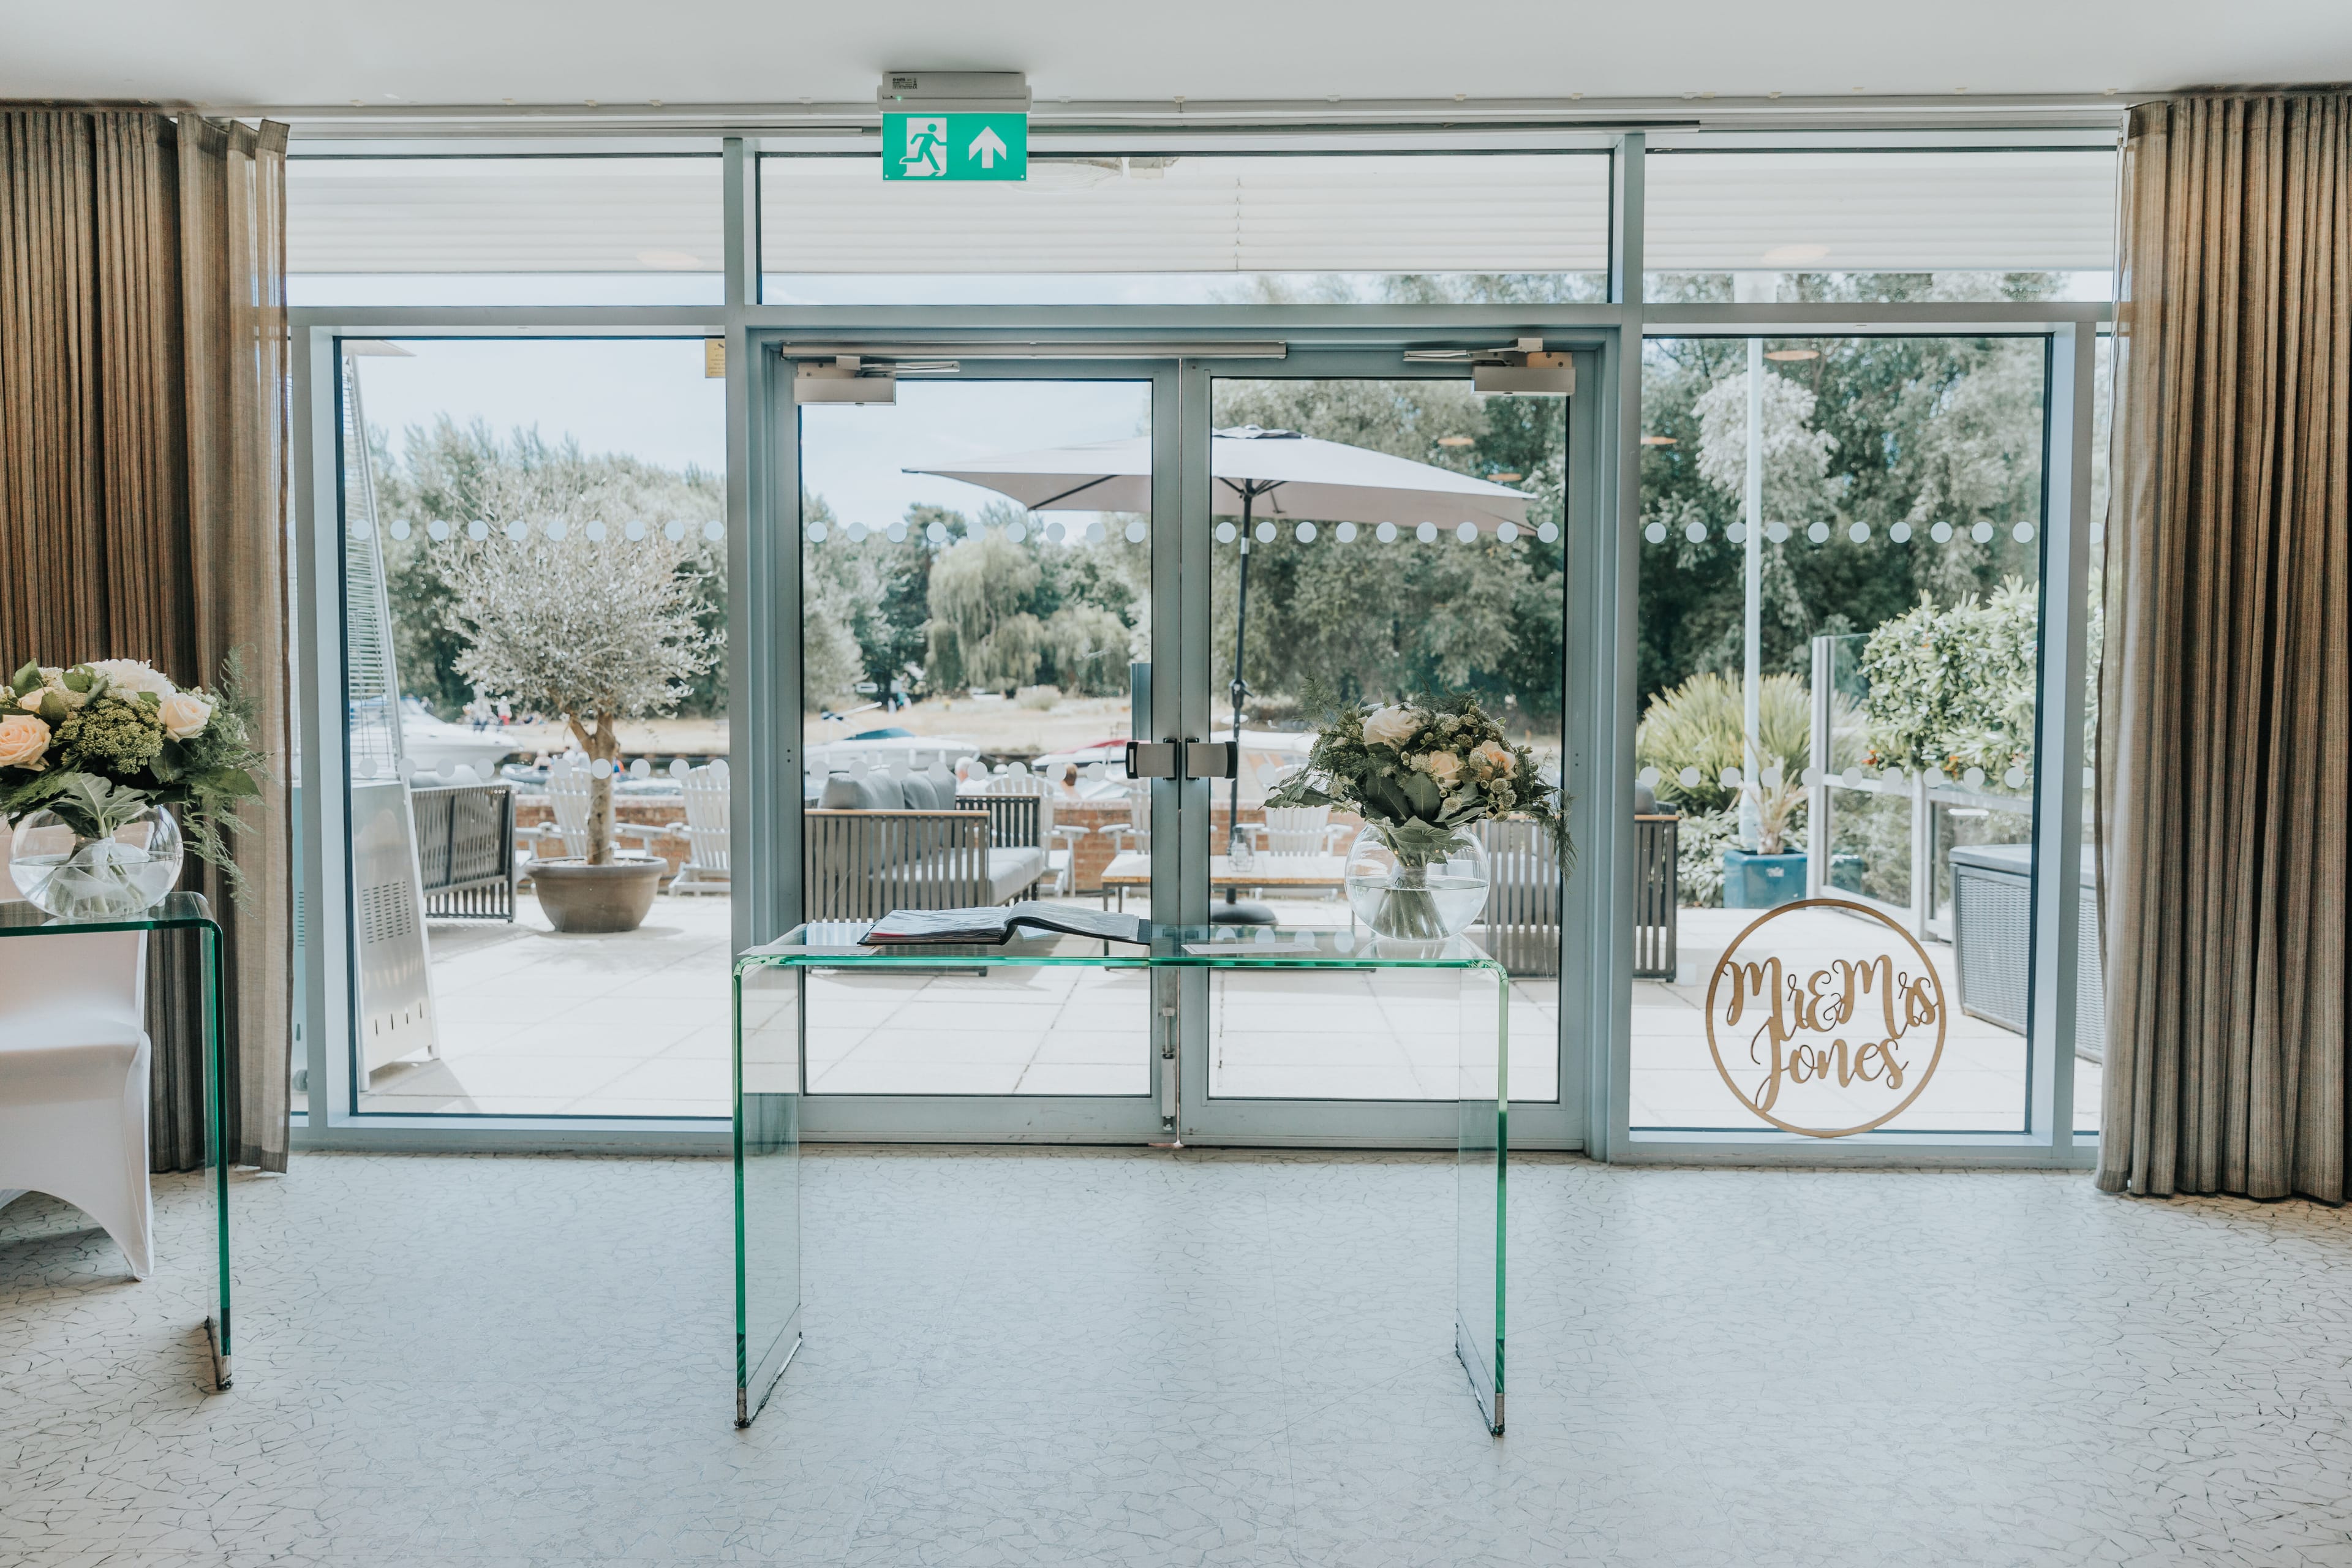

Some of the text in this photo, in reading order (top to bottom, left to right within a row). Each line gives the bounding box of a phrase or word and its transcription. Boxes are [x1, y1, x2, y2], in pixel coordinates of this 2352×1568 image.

[1723, 957, 1808, 1041] Mr
[1832, 955, 1937, 1039] Mrs
[1751, 1017, 1909, 1112] Jones
